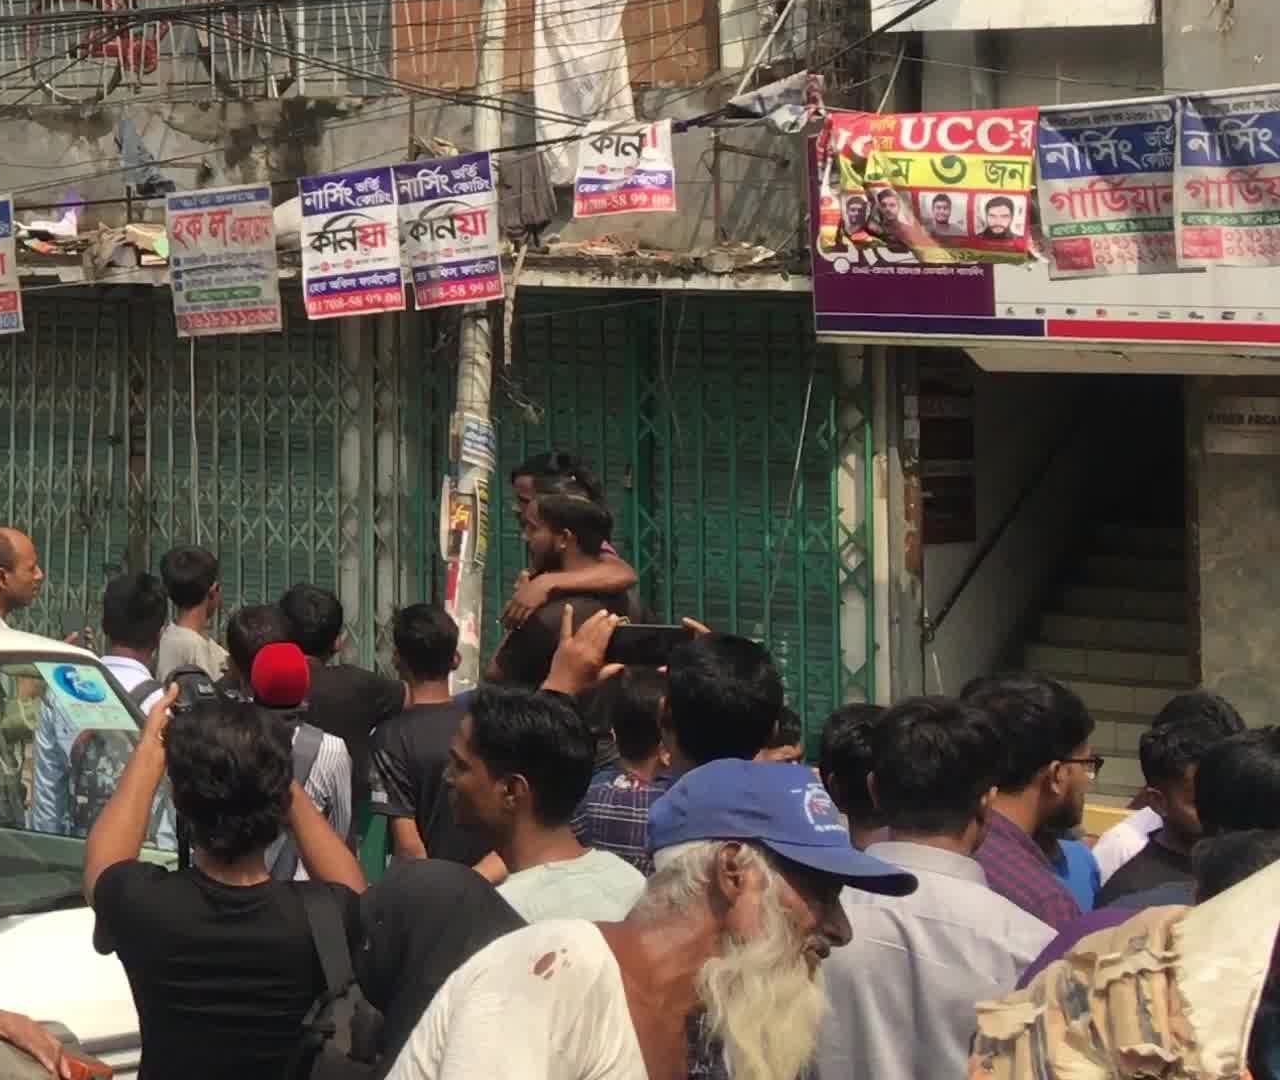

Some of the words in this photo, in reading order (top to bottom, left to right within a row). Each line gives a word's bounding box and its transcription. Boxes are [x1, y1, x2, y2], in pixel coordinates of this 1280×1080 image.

[1039, 127, 1141, 173] নার্সিং
[1183, 113, 1280, 161] নার্সিং
[398, 166, 453, 201] নার্সিং
[450, 162, 479, 180] ভর্তি
[930, 154, 968, 185] ৩
[983, 159, 1030, 188] জন
[304, 178, 356, 211] নার্সিং
[354, 176, 381, 193] ভর্তি
